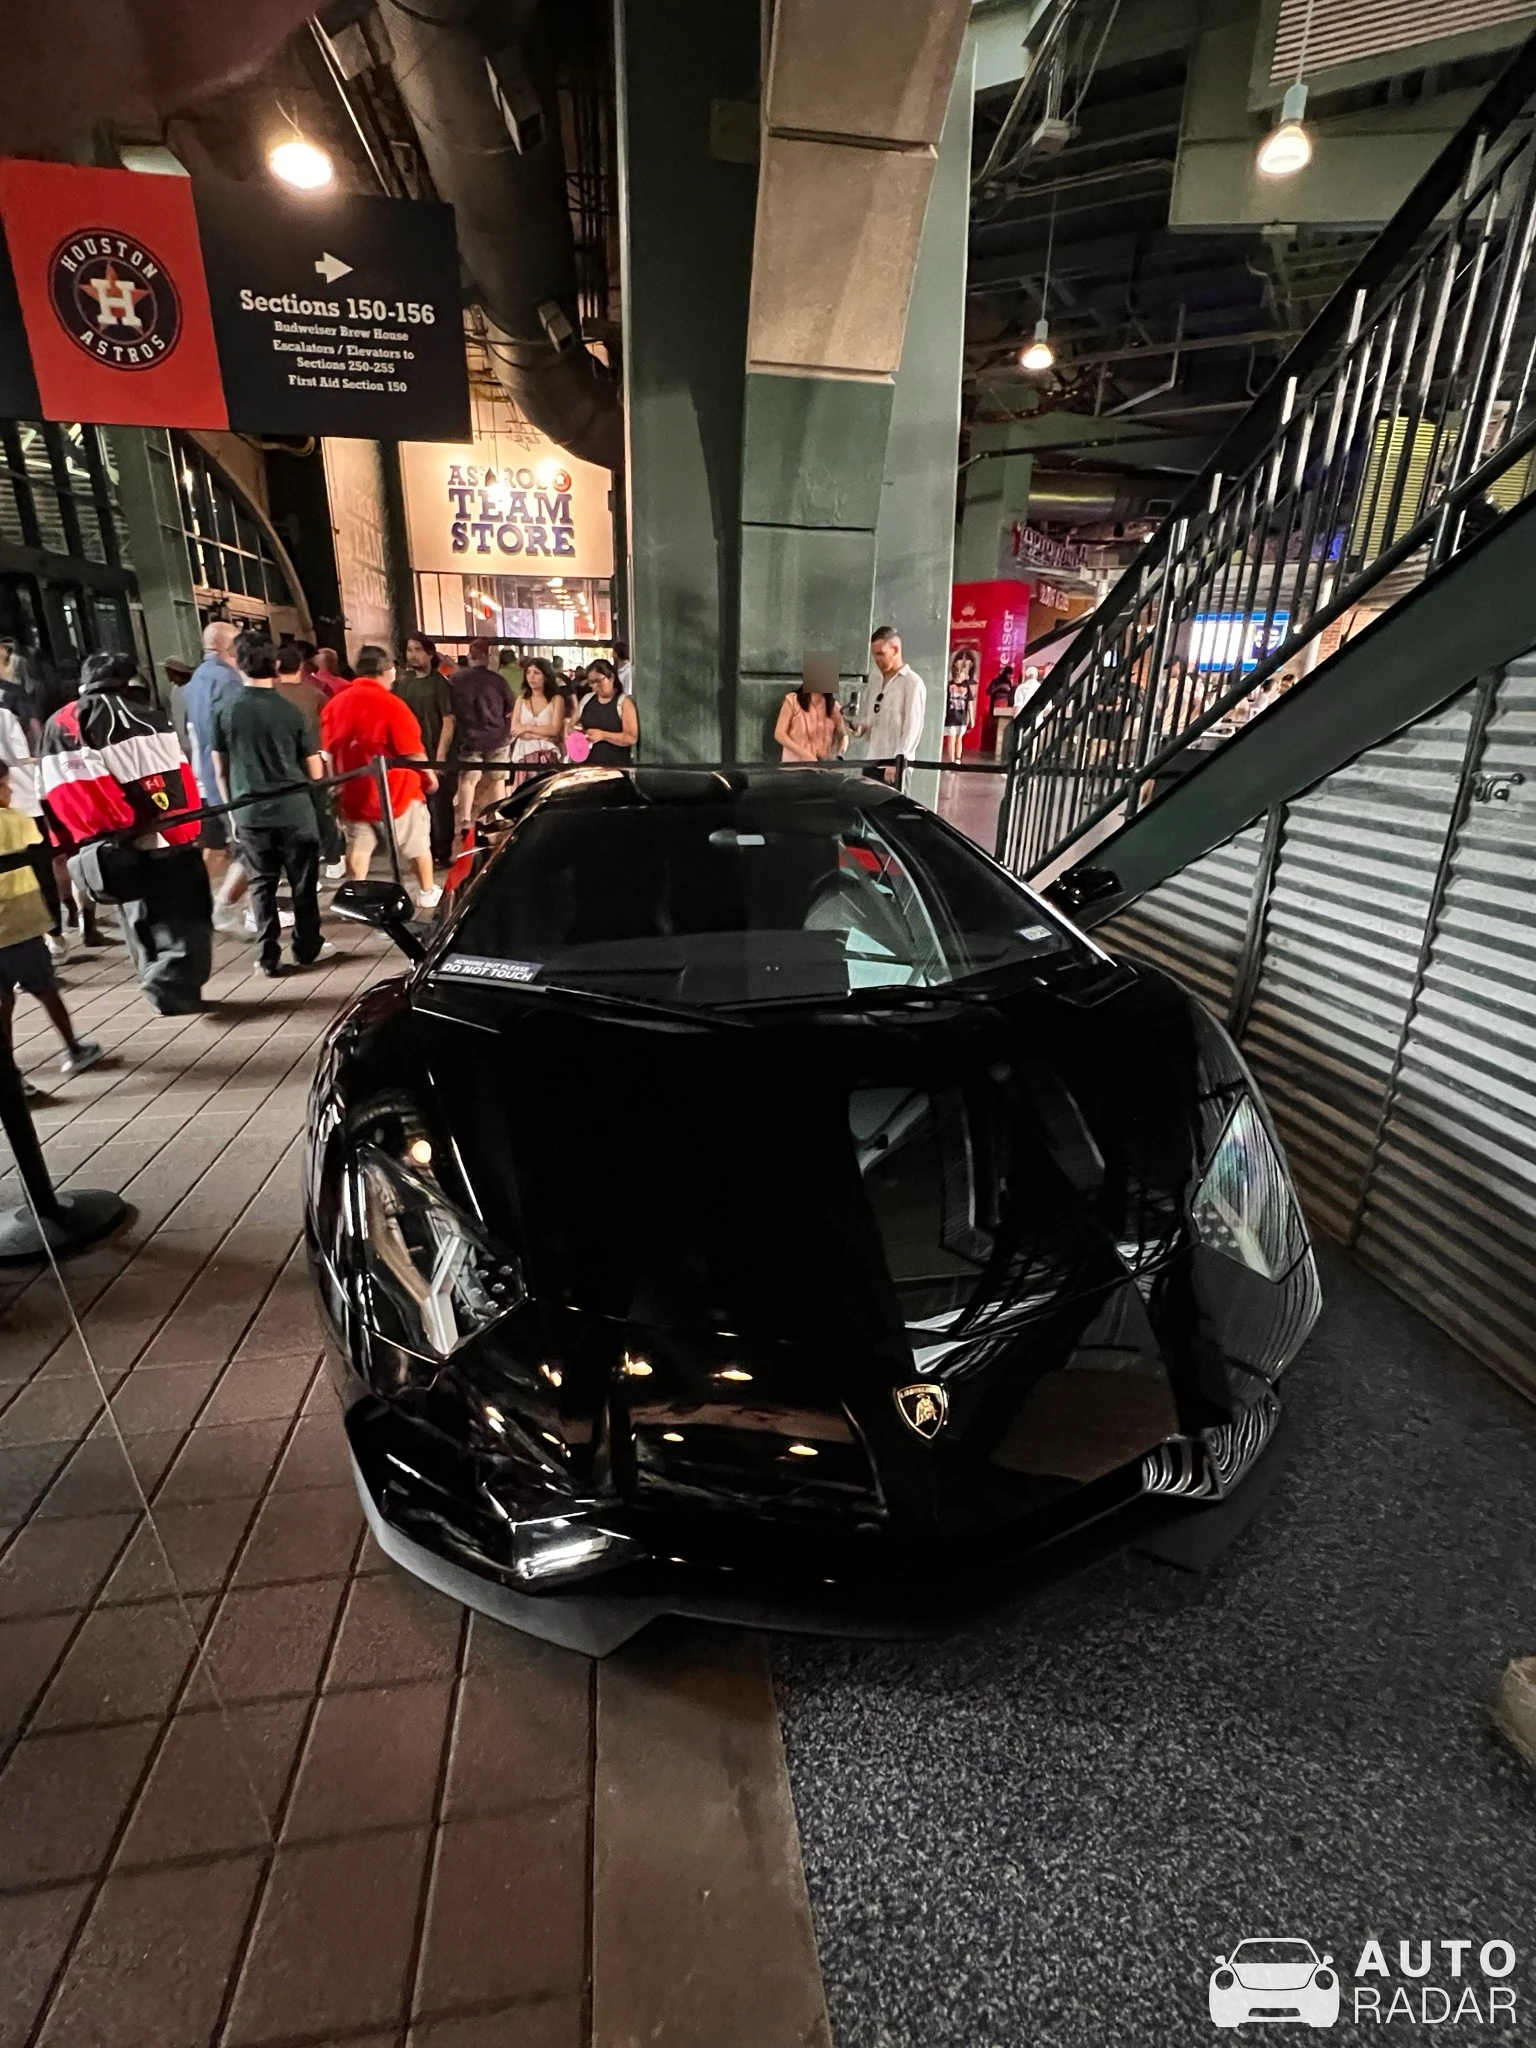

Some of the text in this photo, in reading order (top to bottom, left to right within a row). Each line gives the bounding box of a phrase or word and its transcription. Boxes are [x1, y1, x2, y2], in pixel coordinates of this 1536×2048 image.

[60, 237, 158, 279] HOUSTON
[90, 278, 142, 328] H
[239, 289, 435, 325] Sections 150-156
[273, 320, 409, 341] Budweiser Brew House
[80, 330, 165, 363] ASTROS
[272, 339, 335, 355] Escalators
[345, 344, 401, 360] Elevators
[403, 350, 415, 360] to
[296, 357, 396, 374] Sections 250-255
[287, 374, 408, 392] First Aid Section 150
[447, 464, 549, 491] ASRO
[448, 487, 574, 526] TEAM
[450, 521, 577, 558] STORE
[442, 963, 533, 981] DO NOT TOUCH
[501, 964, 530, 972] PLEASE
